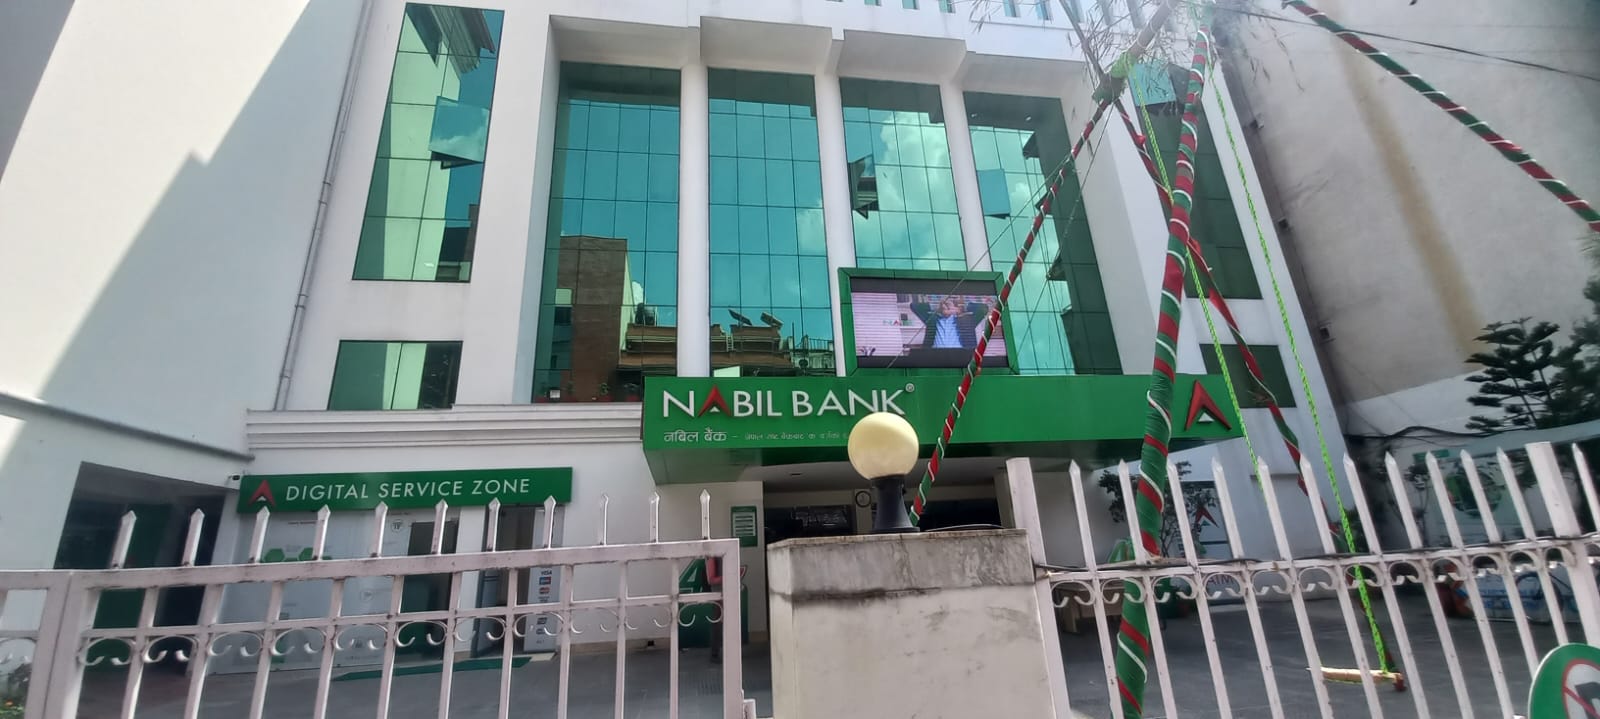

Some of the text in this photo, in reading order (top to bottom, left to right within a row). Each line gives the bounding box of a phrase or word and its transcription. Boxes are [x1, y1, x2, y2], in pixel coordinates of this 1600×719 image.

[663, 384, 905, 418] NABIL BANK
[663, 429, 699, 442] नबिल
[703, 427, 727, 442] बैंक
[286, 478, 531, 501] DIGITAL SERVICE ZONE
